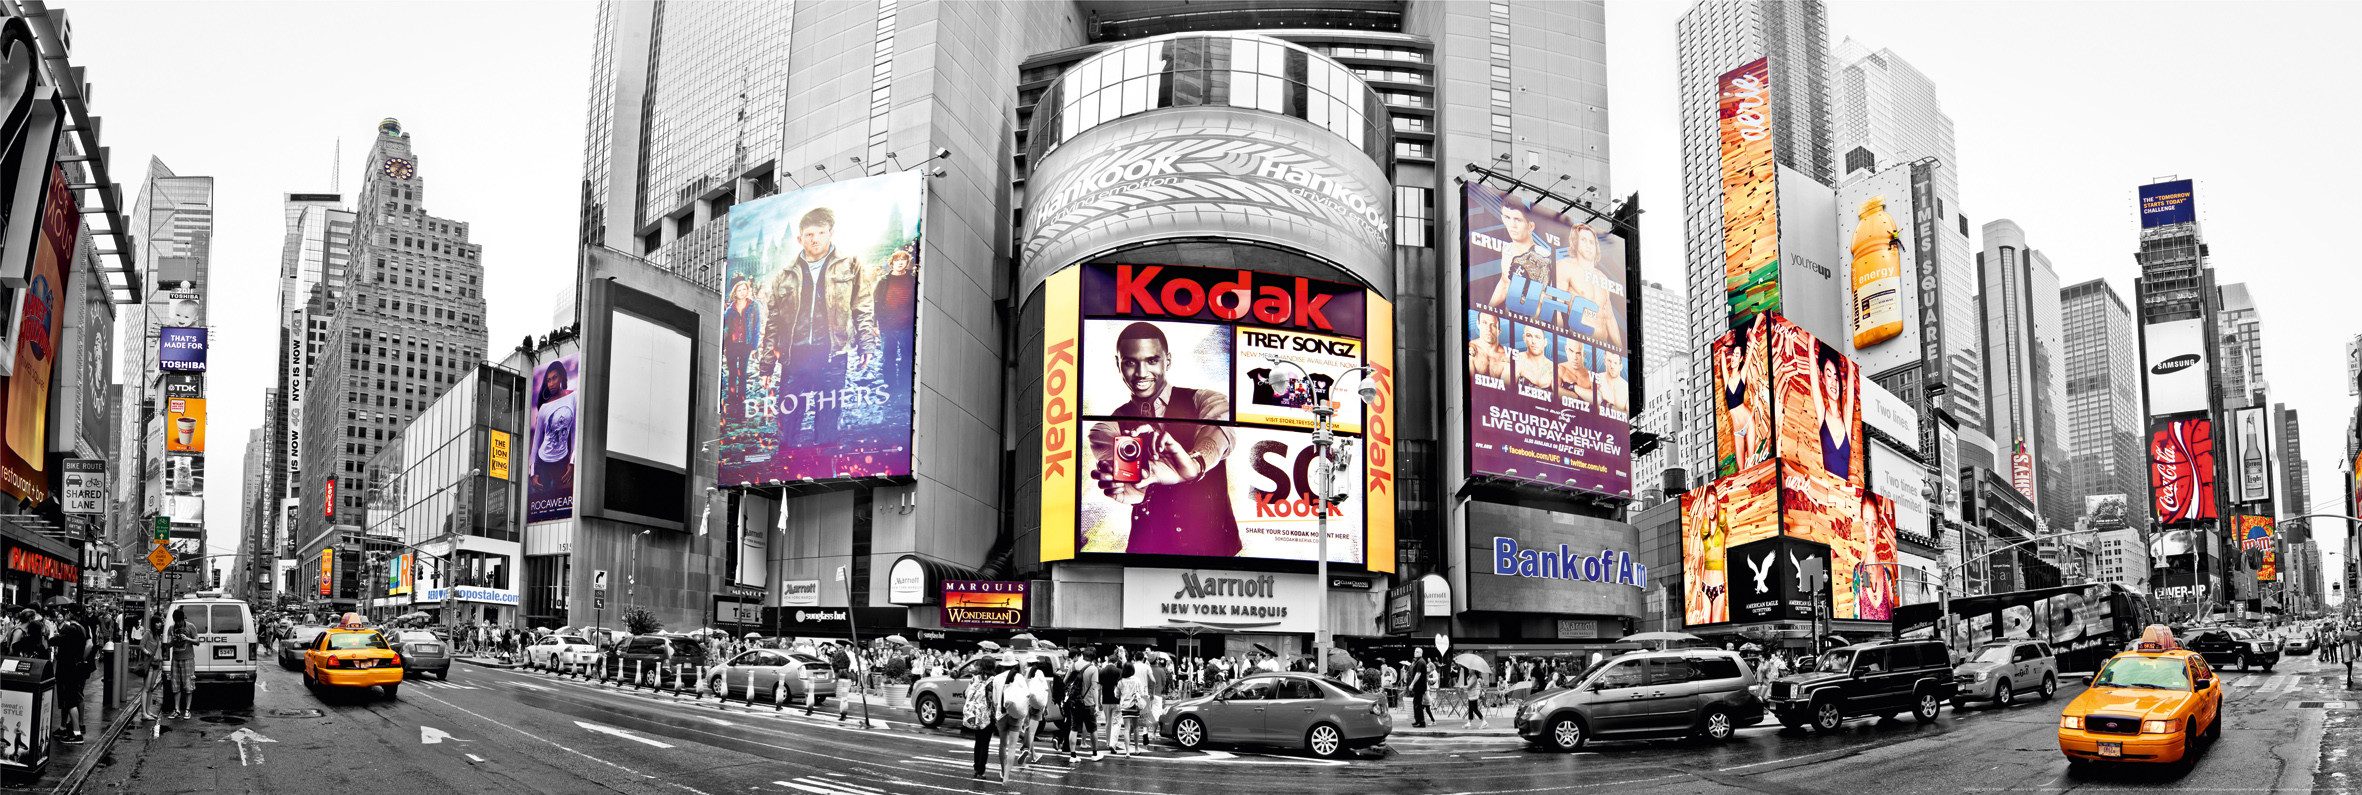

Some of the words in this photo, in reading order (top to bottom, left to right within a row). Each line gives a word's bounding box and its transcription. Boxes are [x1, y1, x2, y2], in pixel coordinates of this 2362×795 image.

[1098, 176, 1179, 200] emotion
[1292, 186, 1348, 216] driving
[2144, 205, 2176, 214] CHALLENGE
[1914, 180, 1934, 252] TIMES
[1858, 266, 1895, 284] energy
[1115, 264, 1334, 331] Kodak
[1506, 273, 1600, 336] UFC
[1920, 260, 1938, 362] SQUARE
[1242, 330, 1290, 349] TREY
[1292, 336, 1356, 358] SONGZ
[162, 361, 205, 369] TOSHIBA
[1258, 352, 1306, 363] MERHANDISE
[2157, 358, 2195, 370] SAMSUNG
[292, 367, 300, 376] IS
[1475, 373, 1505, 391] SILVA
[743, 384, 890, 418] BROTHERS
[1518, 384, 1552, 402] LEBEN
[1044, 338, 1075, 481] Kodak
[1562, 396, 1590, 413] ORTIZ
[1599, 406, 1628, 423] BADER
[1875, 399, 1891, 418] Two
[1892, 413, 1910, 431] lines.
[1368, 360, 1391, 496] Kodak
[1489, 406, 1568, 433] SATURDAY
[1571, 425, 1602, 442] JULY
[1606, 434, 1614, 445] 2
[495, 439, 506, 447] THE
[1482, 415, 1512, 431] LIVE
[1515, 422, 1536, 437] ON
[1538, 426, 1621, 456] PAY-PER-VIEW
[492, 447, 507, 458] LION
[1509, 446, 1561, 464] facebook.com/UFC
[291, 460, 298, 470] IS
[492, 460, 507, 470] KING
[1, 465, 31, 494] restaurant
[1885, 470, 1899, 487] Two
[1900, 478, 1917, 496] times
[66, 490, 102, 499] SHARED
[531, 496, 573, 511] ROCAWEAR
[72, 501, 95, 509] LANE
[1493, 536, 1580, 581] Bank
[1583, 549, 1614, 583] of
[785, 584, 816, 595] Marriott
[946, 583, 1024, 591] MARQUIS
[1174, 572, 1275, 599] Marriott
[806, 611, 834, 622] sunglass
[834, 611, 846, 620] hut
[948, 608, 1020, 624] WONDERLAND
[1161, 603, 1190, 614] NEW
[1193, 603, 1227, 616] YORK
[1231, 605, 1288, 618] MARQUIS
[1559, 621, 1597, 632] Marriott
